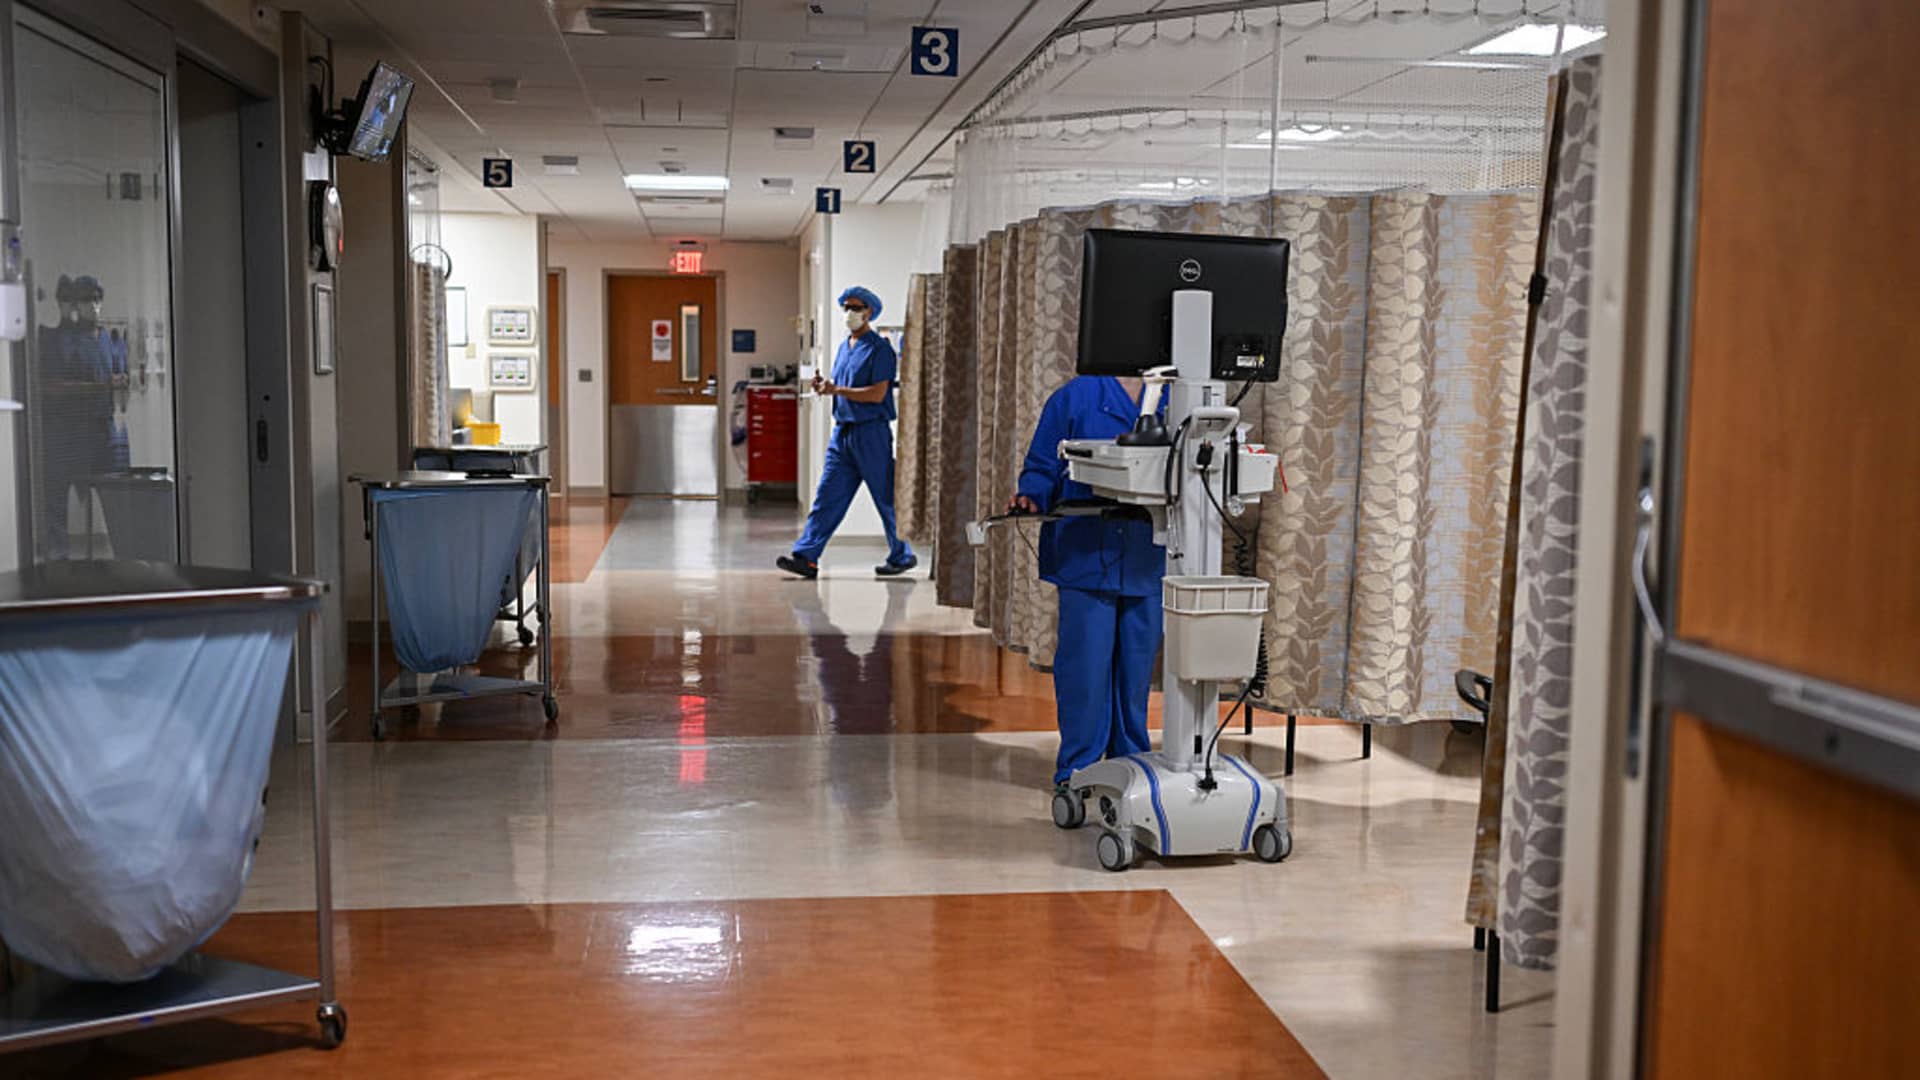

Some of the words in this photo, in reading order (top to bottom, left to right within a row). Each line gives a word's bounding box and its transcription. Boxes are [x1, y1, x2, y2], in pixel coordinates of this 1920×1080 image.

[920, 31, 950, 73] 3
[850, 143, 871, 171] 2
[489, 161, 507, 186] 5
[823, 190, 834, 212] 1
[676, 252, 702, 272] EXIT
